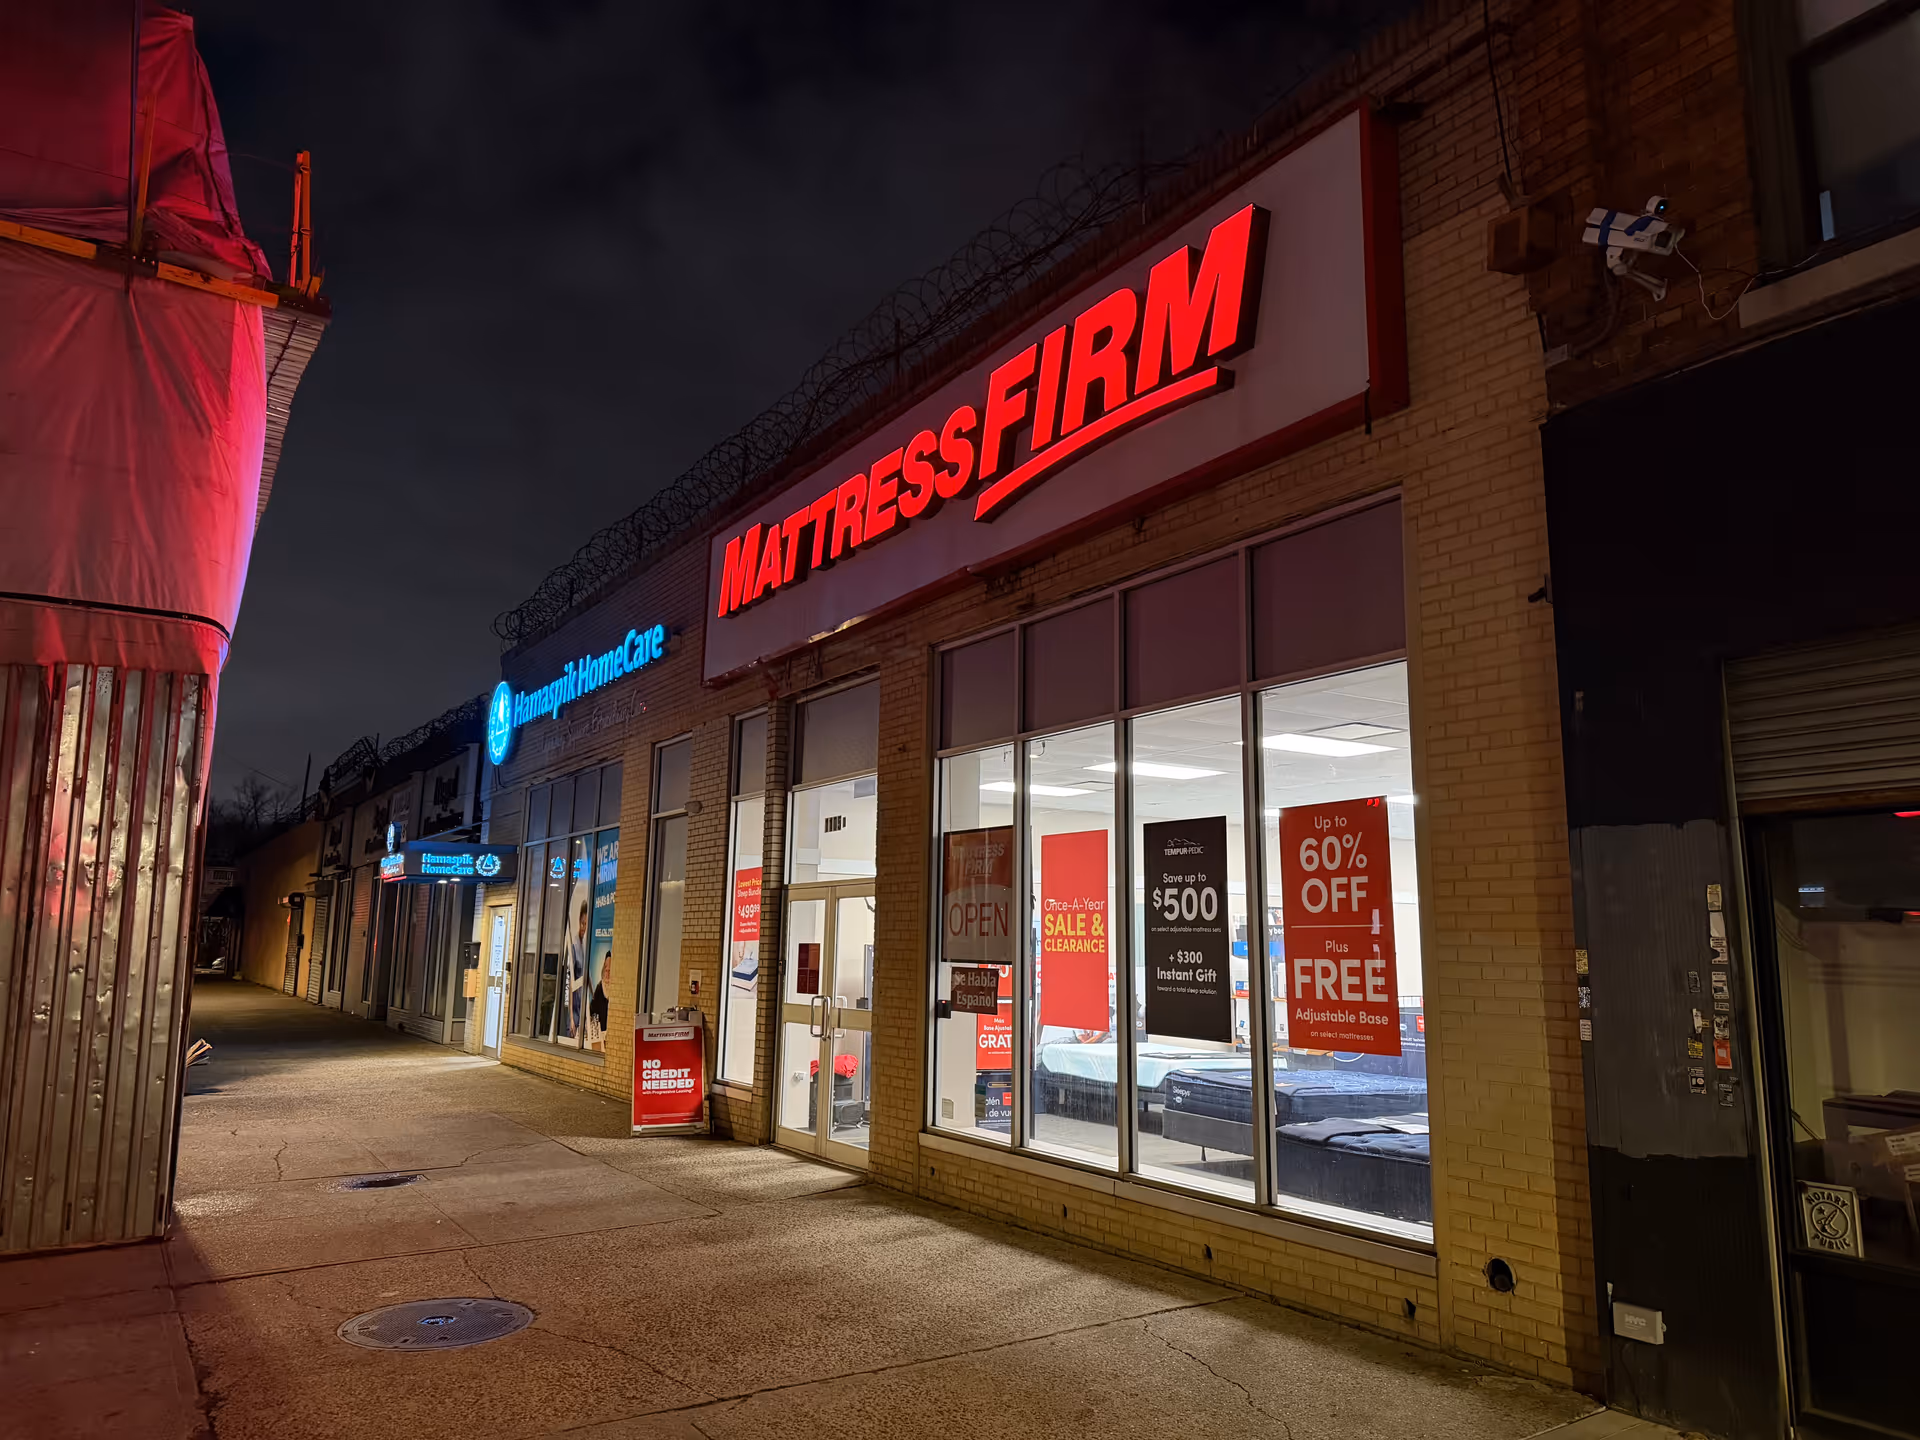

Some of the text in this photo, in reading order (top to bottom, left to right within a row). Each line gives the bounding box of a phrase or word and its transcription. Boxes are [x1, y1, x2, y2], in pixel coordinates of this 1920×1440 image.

[513, 660, 578, 728] Hamaspik
[578, 623, 665, 697] HomeCare
[1314, 815, 1347, 832] Up to
[422, 853, 474, 866] Hamaspik
[596, 845, 609, 866] WE
[1299, 831, 1368, 872] 60%
[421, 864, 474, 875] HomeCare
[1162, 873, 1207, 885] Save up to
[1152, 886, 1218, 921] $500
[1301, 876, 1369, 914] OFF
[1044, 897, 1105, 912] Once-A-Year
[949, 902, 1009, 937] OPEN
[1044, 912, 1105, 937] SALE &
[1044, 938, 1105, 953] CLEARANCE
[1325, 940, 1349, 953] Plus
[1177, 950, 1203, 965] $300
[953, 971, 997, 988] Se Habla
[1156, 967, 1217, 983] Instant Gift
[1294, 958, 1389, 1003] FREE
[956, 990, 995, 1008] Español
[1295, 1008, 1389, 1026] Adjustable Base
[1319, 1030, 1338, 1038] select
[1339, 1032, 1374, 1041] mattresses
[642, 1059, 662, 1069] NO
[642, 1068, 691, 1079] CREDIT
[989, 1109, 999, 1118] de
[1805, 1191, 1849, 1209] NOTARY
[1811, 1233, 1851, 1251] PUBLIC
